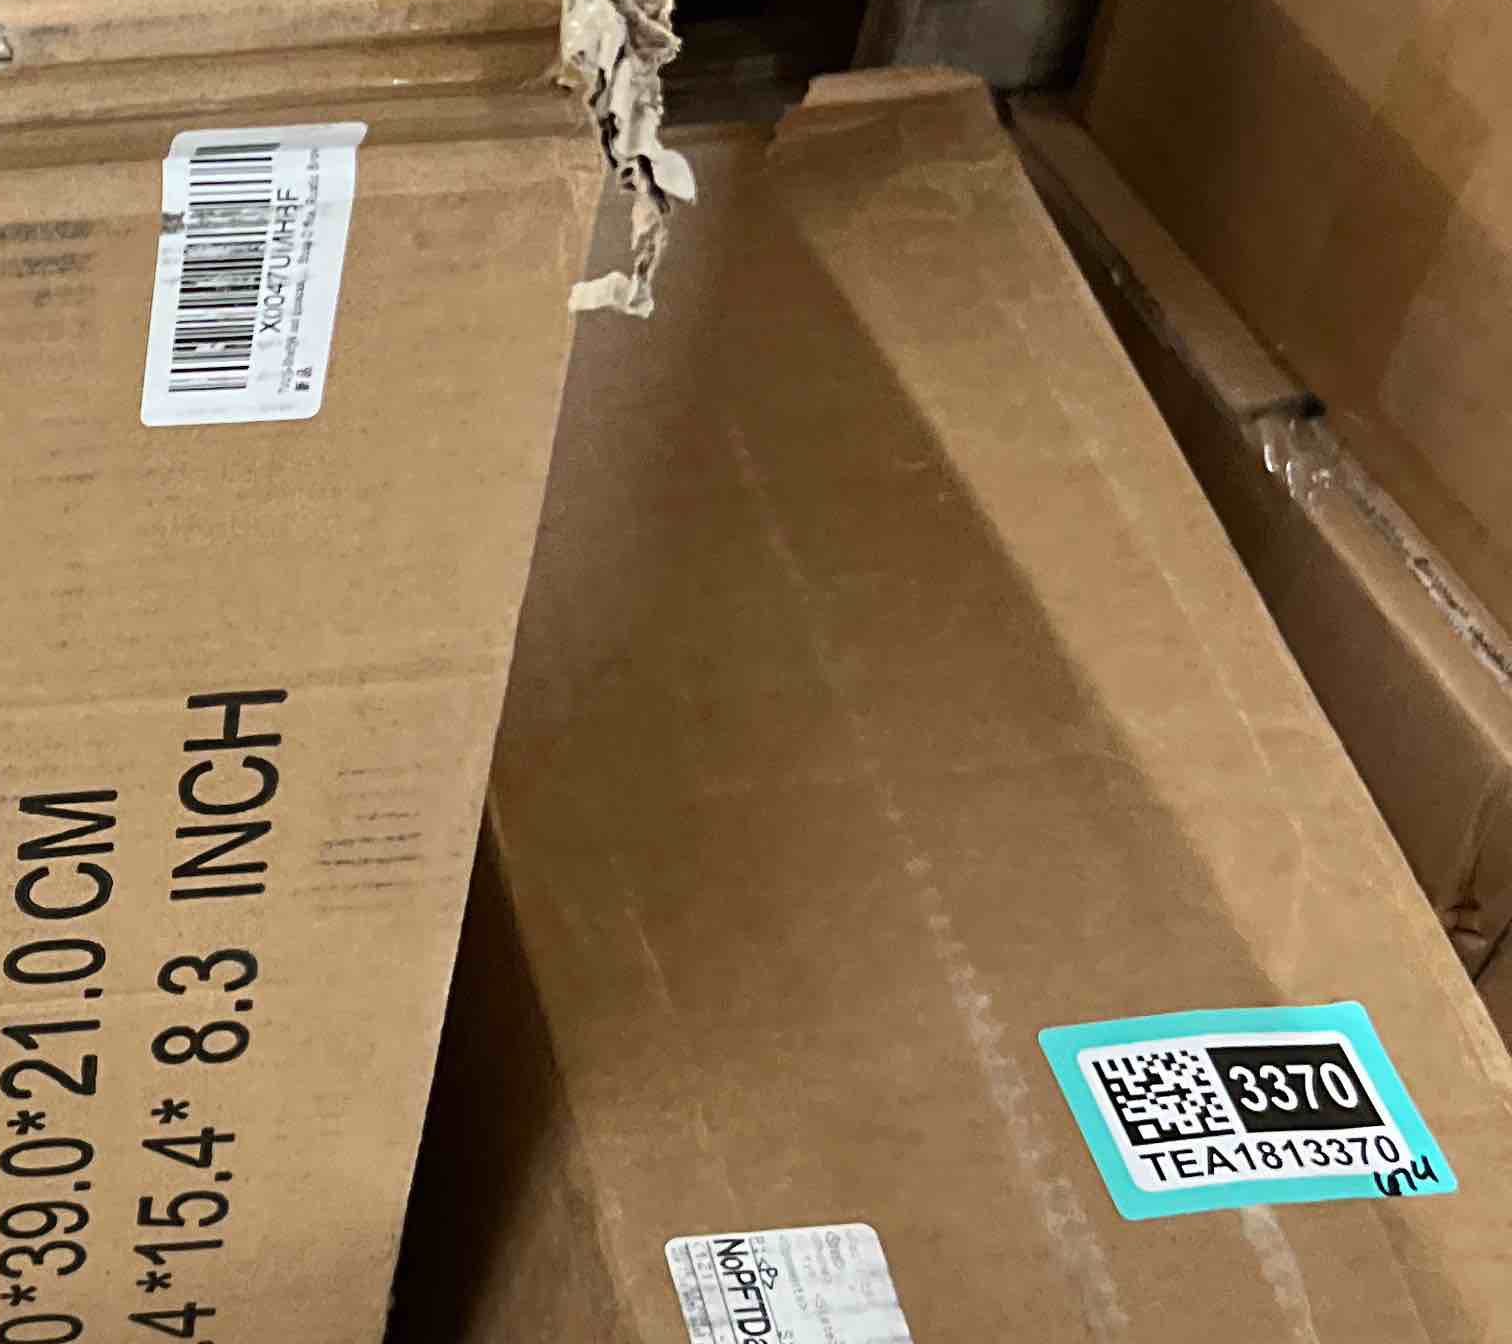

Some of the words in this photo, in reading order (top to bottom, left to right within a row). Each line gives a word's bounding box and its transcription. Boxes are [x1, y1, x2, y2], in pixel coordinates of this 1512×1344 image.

[168, 688, 288, 903] INCH
[1228, 1060, 1360, 1114] 3370
[1138, 1134, 1402, 1183] TEA1813370
